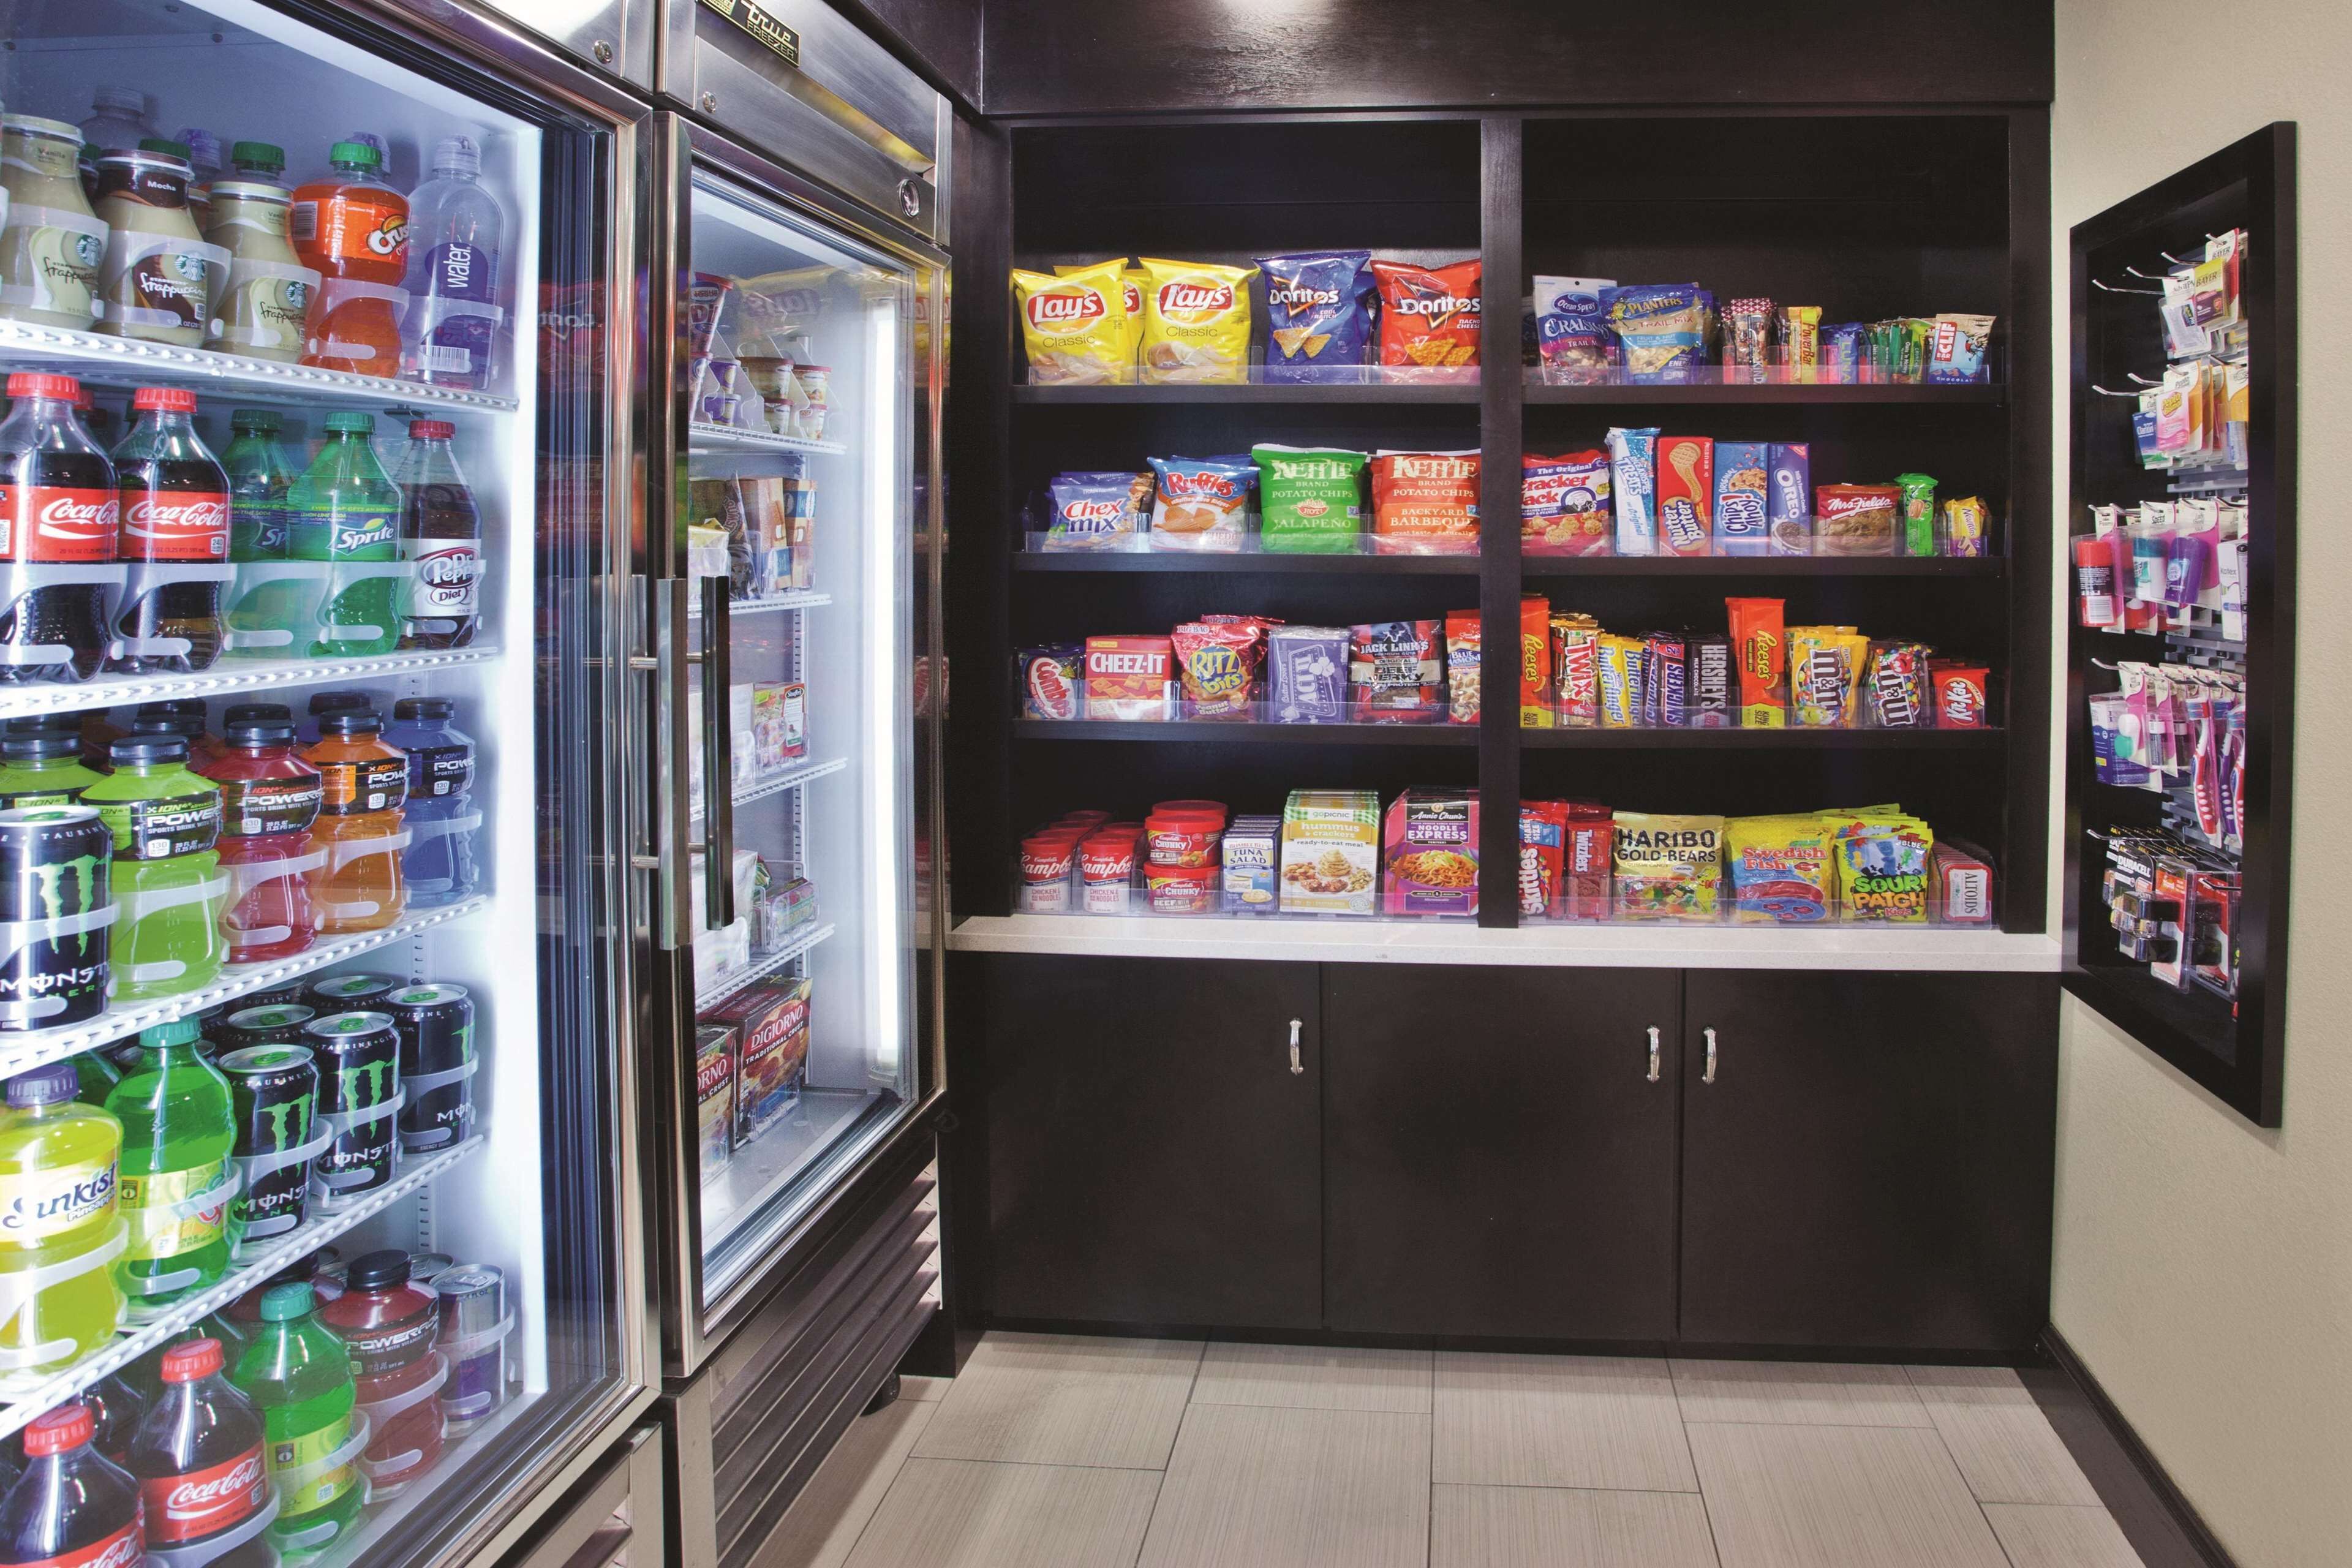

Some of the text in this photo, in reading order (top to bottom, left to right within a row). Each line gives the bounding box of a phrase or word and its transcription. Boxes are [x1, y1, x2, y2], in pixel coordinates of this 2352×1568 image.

[741, 0, 794, 50] true
[747, 20, 794, 59] FREEZER
[147, 180, 176, 192] Mocha
[447, 243, 473, 289] water.
[140, 272, 206, 298] frappuccin
[2196, 271, 2217, 287] BAYER
[1034, 292, 1102, 323] Lay's
[1165, 284, 1231, 311] Lay's
[1270, 288, 1340, 305] Doritos
[1394, 297, 1480, 315] Doritos
[1558, 300, 1596, 312] Ocean Spray
[1627, 298, 1683, 314] PLANTERS
[1674, 315, 1694, 324] MIX
[1042, 335, 1095, 348] Classic
[1166, 325, 1218, 338] Classic
[1939, 323, 1956, 353] CLIF
[1803, 322, 1816, 366] PowerBar
[1752, 360, 1764, 385] KIND
[1841, 342, 1852, 382] LUNA
[1270, 458, 1353, 481] KETTLE
[1392, 456, 1477, 479] KETTLE
[1556, 463, 1593, 472] Original
[1616, 456, 1642, 496] TREATS
[1166, 472, 1236, 497] Ruffles
[1719, 468, 1738, 493] ORIGINAL
[1319, 490, 1353, 499] CHIPS
[1441, 489, 1475, 497] CHIPS
[1776, 469, 1800, 519] OREO
[41, 498, 119, 525] Coca-Co
[127, 500, 227, 526] Coca-Cola
[1065, 498, 1127, 518] Chex
[1725, 501, 1749, 532] Chips
[1068, 514, 1118, 534] mix
[1274, 517, 1352, 530] JALAPEÑO
[1390, 517, 1474, 528] BARBEQUE
[1627, 508, 1646, 535] Original
[1664, 505, 1691, 546] Nutter
[1676, 500, 1706, 541] Butter
[1962, 508, 1975, 538] Newtons
[337, 524, 394, 550] Sprite
[451, 552, 474, 570] Dr
[439, 589, 461, 603] Diet
[1176, 625, 1192, 634] BIG
[1360, 639, 1430, 654] JACK LINK'S
[1523, 633, 1545, 682] Reese's
[1756, 630, 1777, 680] Reese's
[1090, 652, 1166, 674] CHEEZ-IT
[1190, 649, 1239, 674] RITZ
[1565, 636, 1596, 699] TWIX
[1201, 672, 1242, 693] bits
[1598, 646, 1624, 724] Butterfinger
[1701, 645, 1727, 709] HERSHEY'S
[1296, 673, 1319, 706] ACT
[1667, 664, 1683, 725] SNICKERS
[1194, 701, 1229, 710] Peanut
[1198, 706, 1229, 716] Butter
[1313, 810, 1349, 820] gopicnic
[1301, 822, 1360, 832] hummus
[1313, 830, 1355, 839] crackers
[1408, 831, 1468, 839] EXPRESS
[1523, 819, 1532, 843] SHARE
[1618, 829, 1716, 848] HARIBO
[1155, 840, 1187, 850] CHUNKY
[1575, 829, 1593, 873] Twizzlers
[1617, 848, 1716, 863] GOLD-BEARS
[1741, 846, 1827, 860] Swedish
[1744, 858, 1789, 871] Fish
[2117, 856, 2151, 878] DURACELL
[1519, 848, 1545, 915] Skittles
[1853, 876, 1922, 892] SOUR
[1852, 892, 1925, 908] PATCH
[1964, 872, 1979, 915] ALTOIDS
[1884, 908, 1913, 917] Kids
[751, 1005, 804, 1049] DIGIORNO
[745, 1020, 804, 1065] TRADITIONAL CRUST
[709, 1076, 729, 1096] CRUST
[167, 1453, 262, 1509] Coca-Cola
